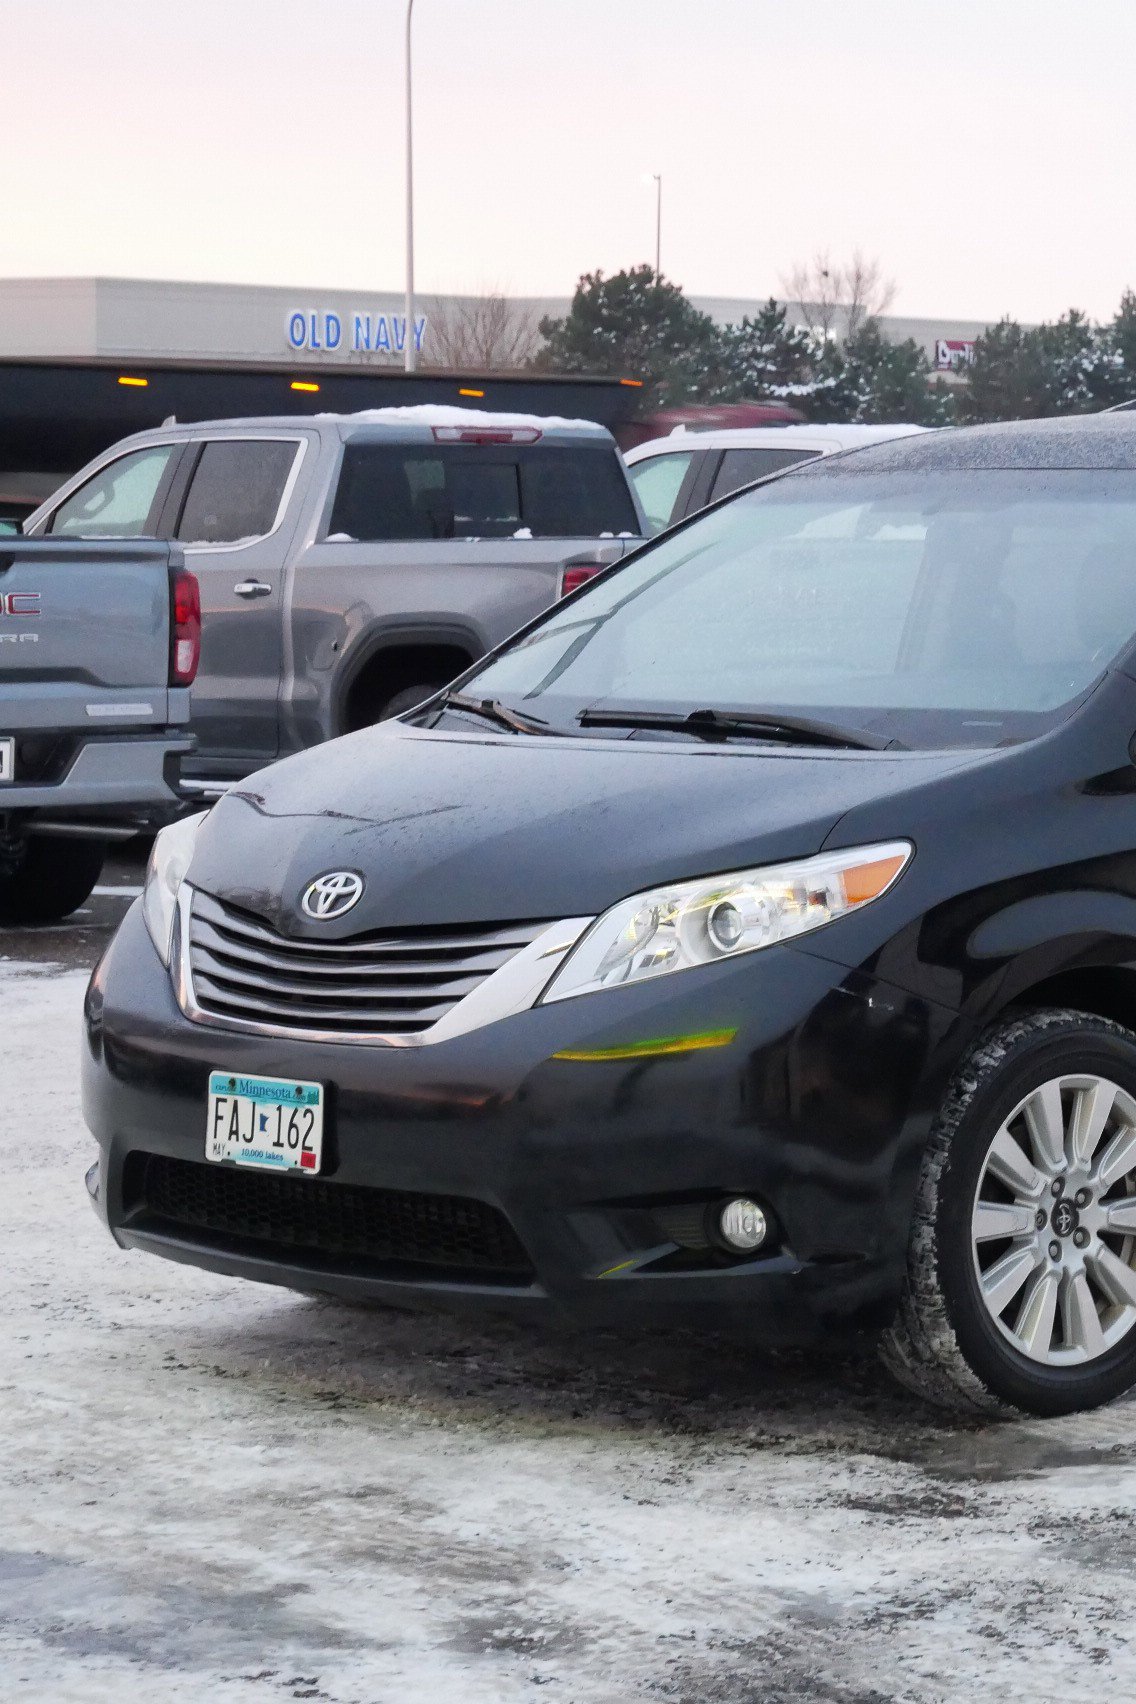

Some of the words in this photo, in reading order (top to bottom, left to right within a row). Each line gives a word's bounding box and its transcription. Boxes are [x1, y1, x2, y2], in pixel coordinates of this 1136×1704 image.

[289, 311, 341, 349] OLD
[354, 314, 427, 351] NAVY
[239, 1080, 292, 1099] Minnesota
[213, 1097, 256, 1143] FAJ
[272, 1104, 315, 1151] 162
